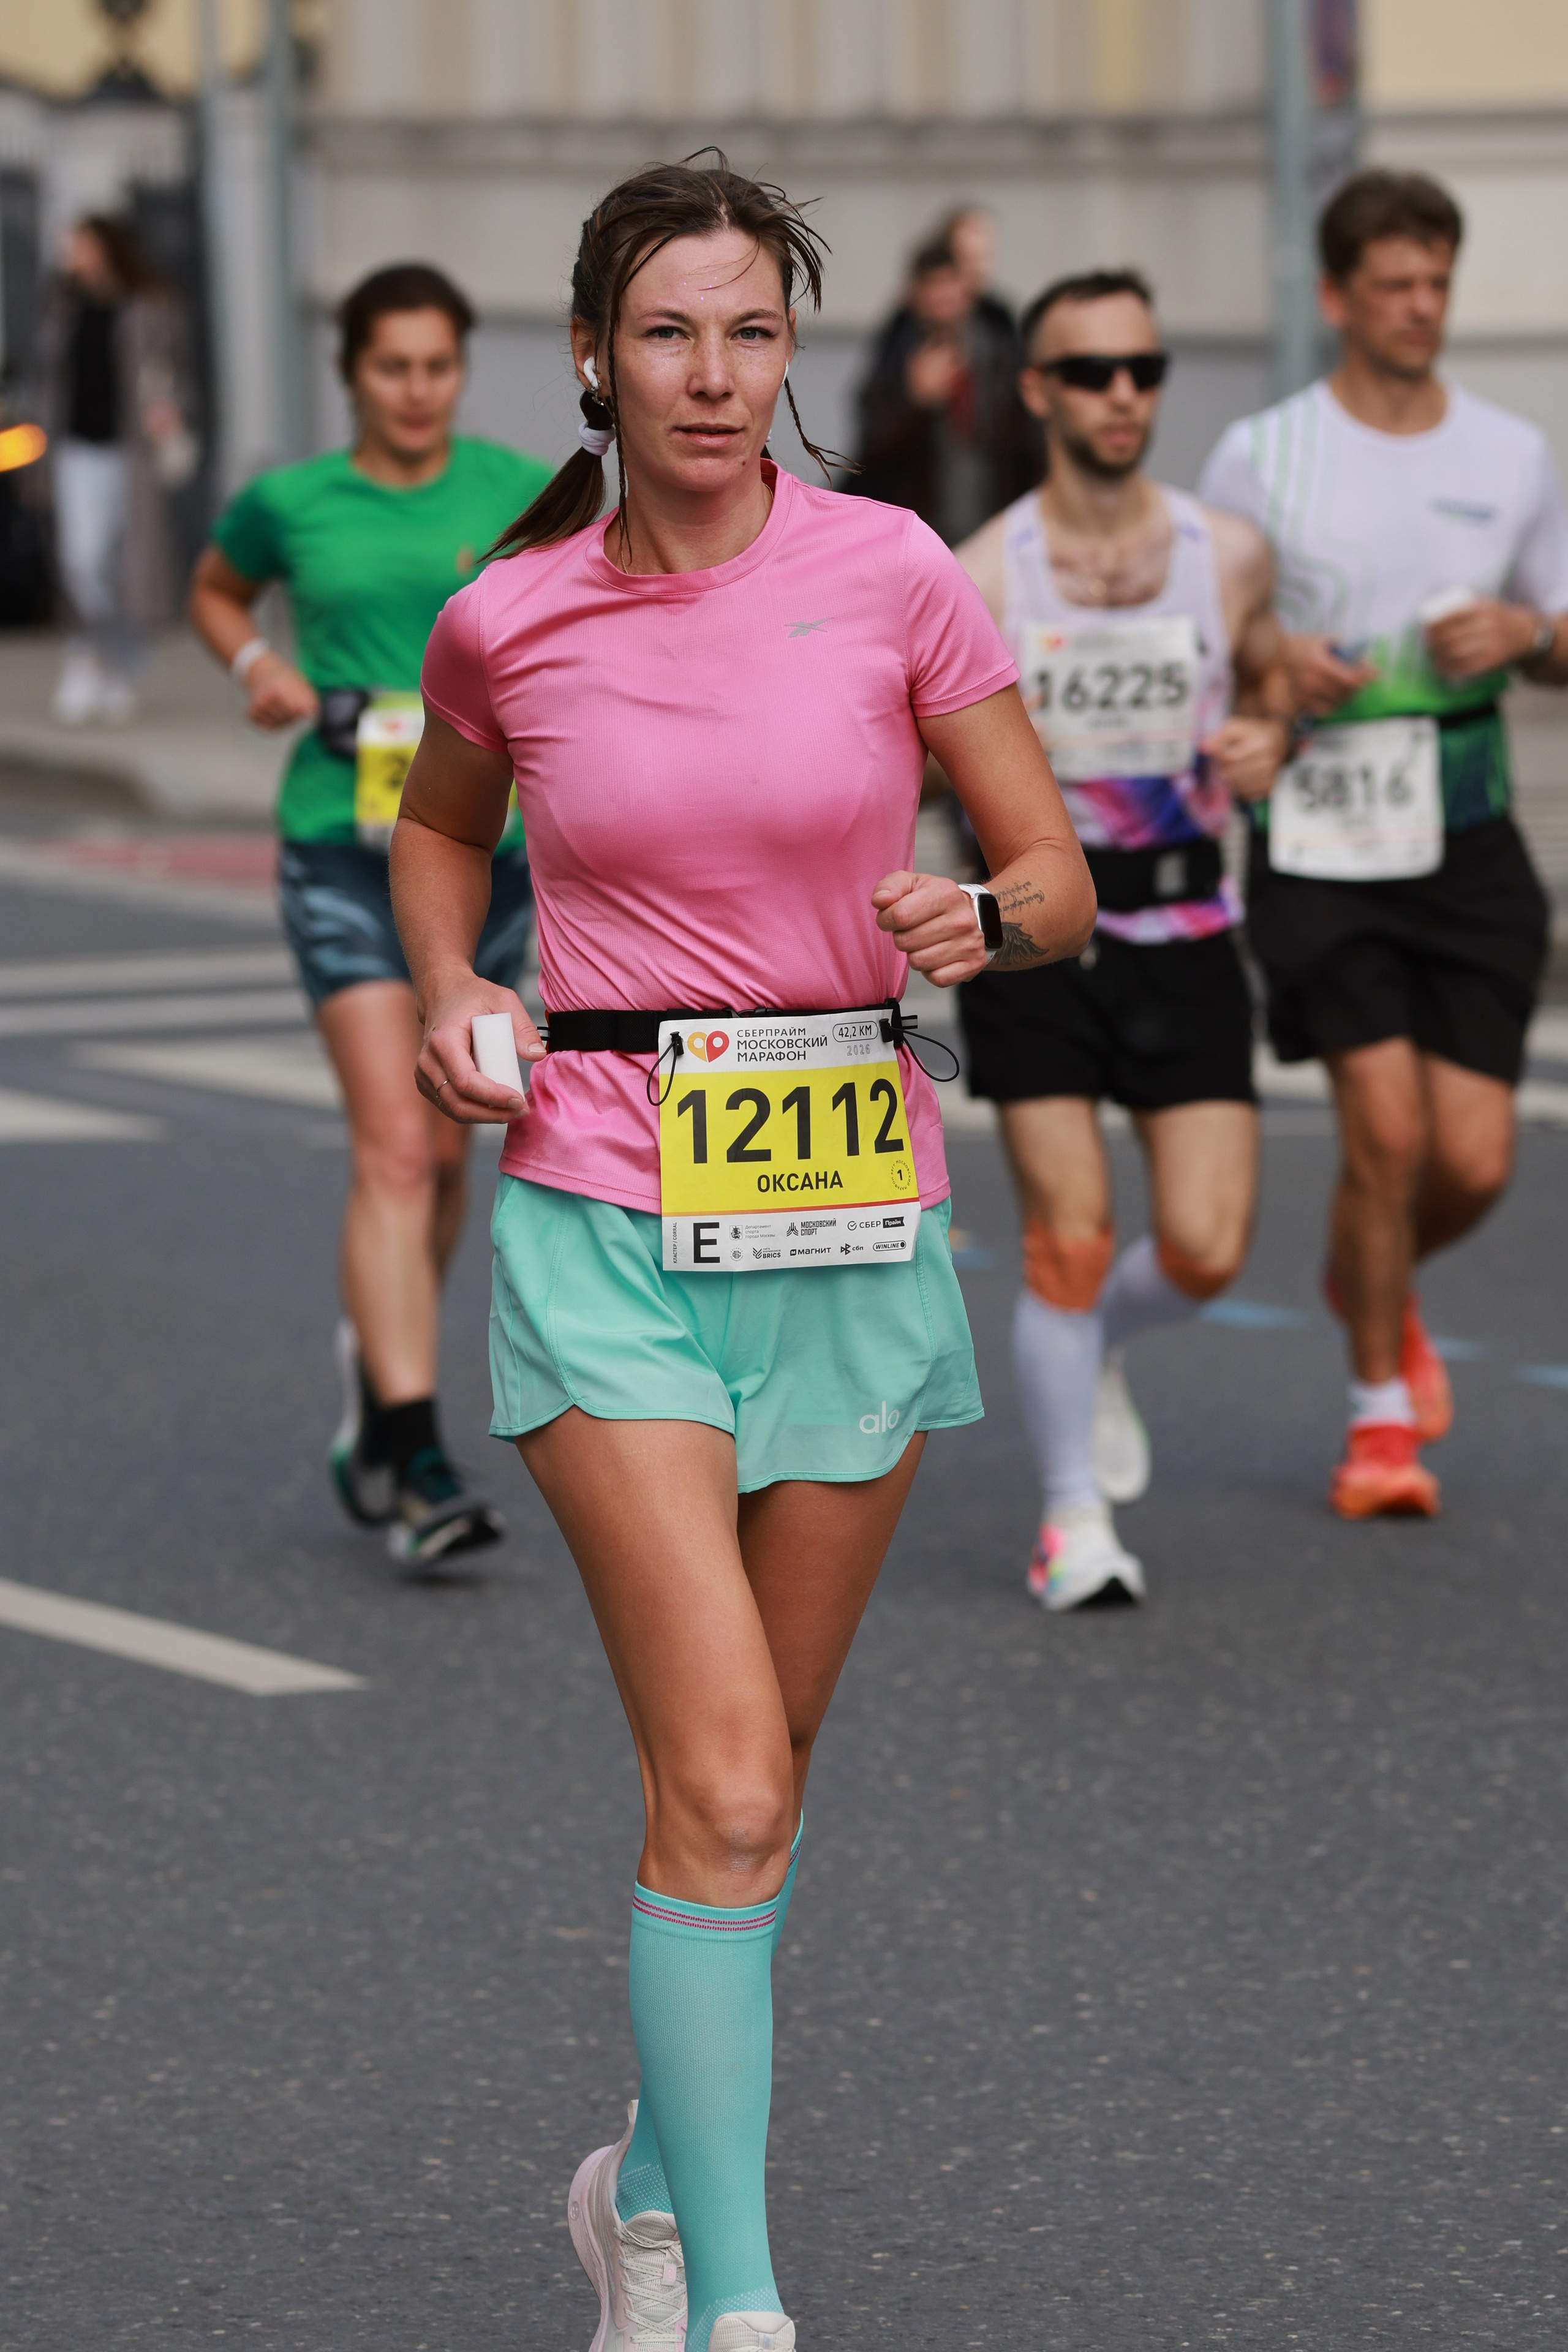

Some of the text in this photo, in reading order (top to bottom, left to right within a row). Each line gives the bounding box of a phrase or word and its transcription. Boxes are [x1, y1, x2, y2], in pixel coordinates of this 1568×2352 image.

[1036, 661, 1190, 715] 16225
[737, 1027, 806, 1037] СБЕРПРАЙМ
[838, 1025, 872, 1039] 42,2 КМ
[737, 1035, 828, 1050] МОСКОВСКИЙ
[737, 1051, 807, 1062] МАРАФОН
[846, 1044, 870, 1056] 2026
[677, 1078, 905, 1164] 12112
[757, 1170, 844, 1193] ОКСАНА
[897, 1169, 903, 1181] 1
[801, 1218, 837, 1229] МОСКОВСКИЙ
[693, 1222, 720, 1263] E
[859, 1400, 900, 1434] alo
